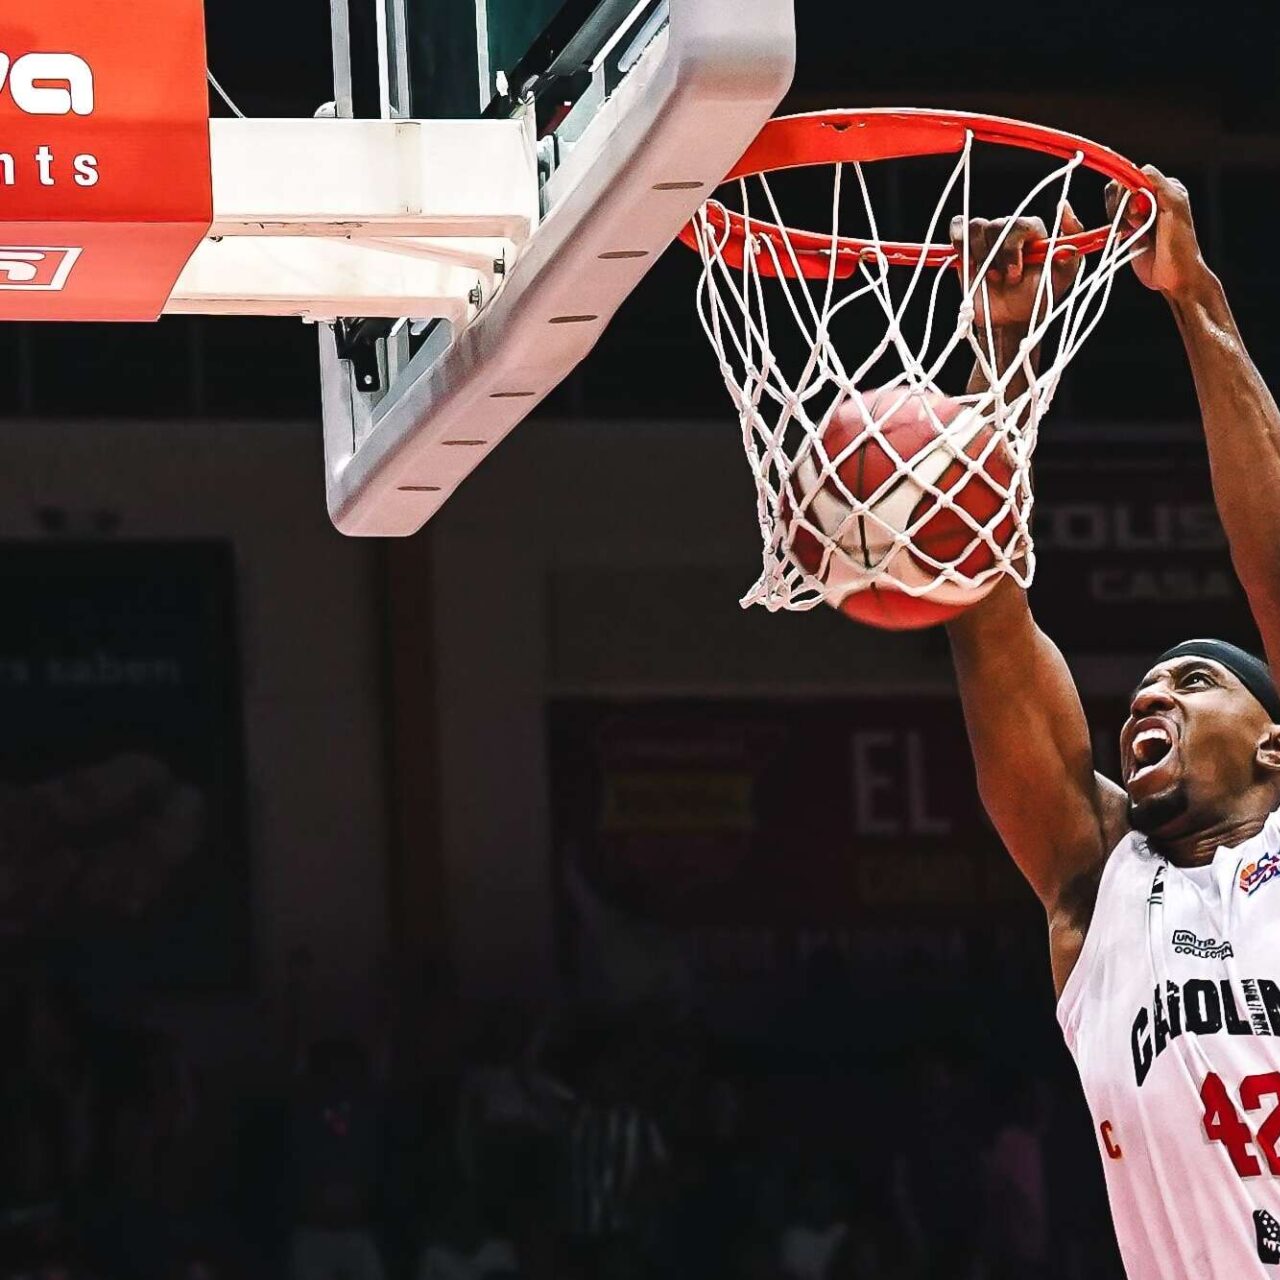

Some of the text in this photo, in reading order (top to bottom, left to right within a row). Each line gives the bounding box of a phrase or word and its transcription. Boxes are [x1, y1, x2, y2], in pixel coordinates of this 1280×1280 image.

[0, 52, 94, 116] a
[850, 729, 951, 835] EL
[1100, 1119, 1122, 1159] C
